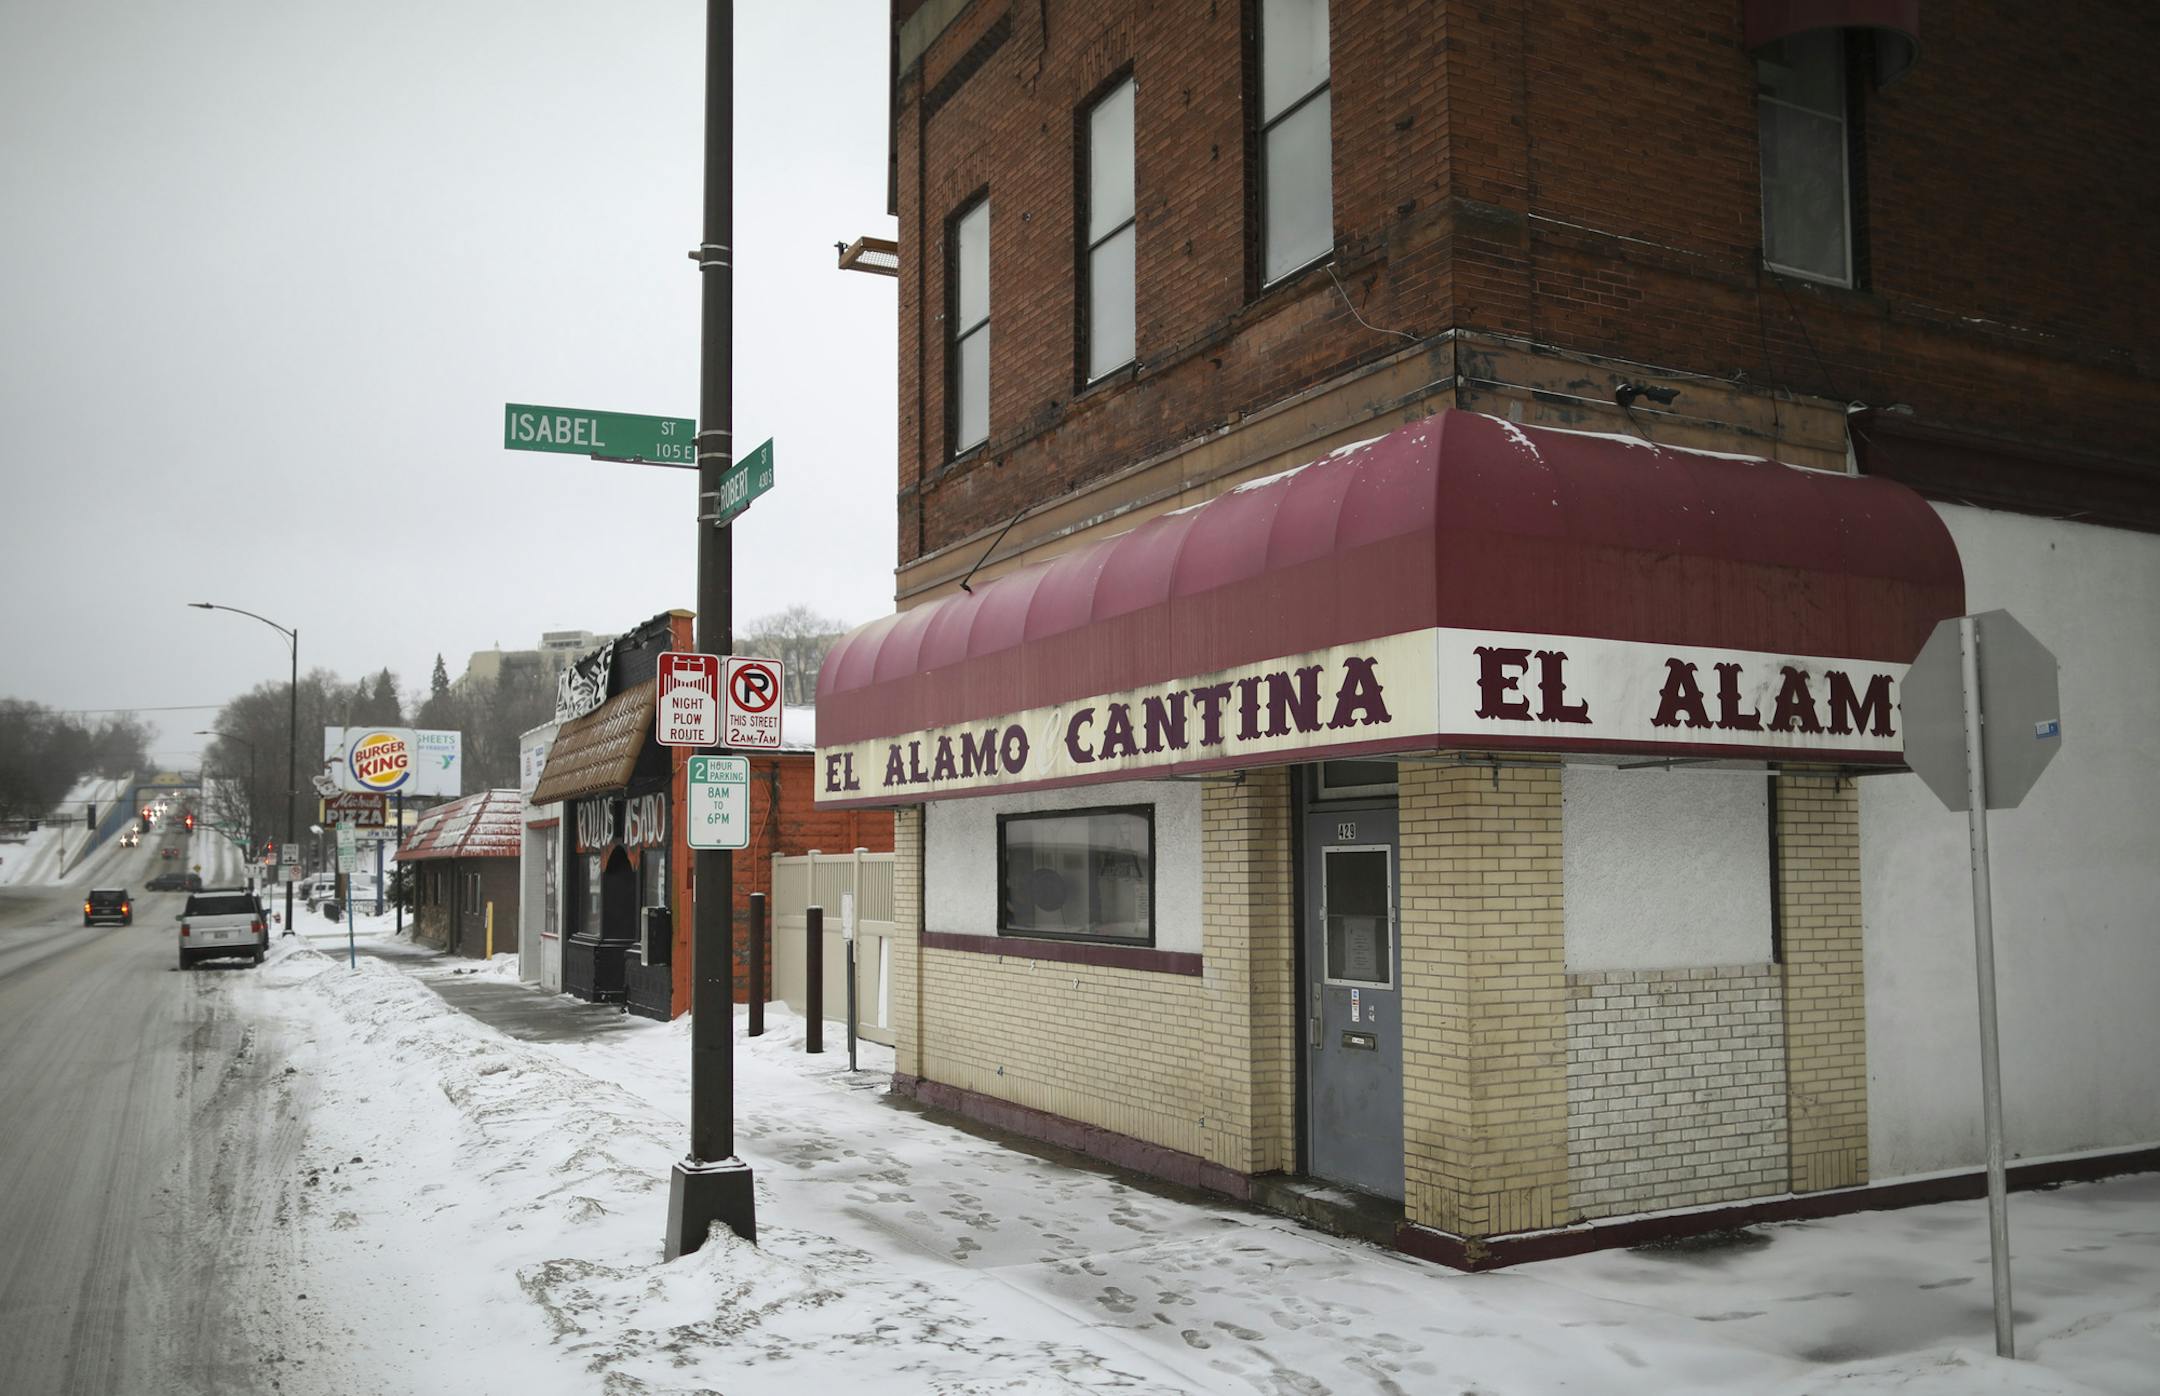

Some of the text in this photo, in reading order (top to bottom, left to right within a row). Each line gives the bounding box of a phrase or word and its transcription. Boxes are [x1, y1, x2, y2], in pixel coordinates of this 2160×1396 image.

[511, 413, 677, 447] ISABEL ST
[656, 443, 692, 459] 105 E
[720, 447, 767, 512] ROBERT ST
[1473, 646, 1901, 738] EL ALAM
[672, 698, 704, 710] NIGHT
[674, 714, 702, 724] PLOW
[730, 715, 778, 727] THIS STREET
[825, 656, 1393, 793] EL ALAMO CANTINA
[671, 729, 705, 741] ROUTE
[731, 729, 777, 744] 2AM-7AM
[355, 741, 405, 763] BURGER
[358, 754, 408, 779] KING
[695, 762, 732, 779] 2 HOUR
[710, 772, 743, 781] PARKING
[708, 787, 729, 799] 8AM
[714, 801, 723, 809] TO
[326, 809, 383, 824] PIZZA
[577, 792, 665, 848] POLLOS ASADO
[707, 813, 729, 825] 6PM
[1338, 824, 1355, 839] 429
